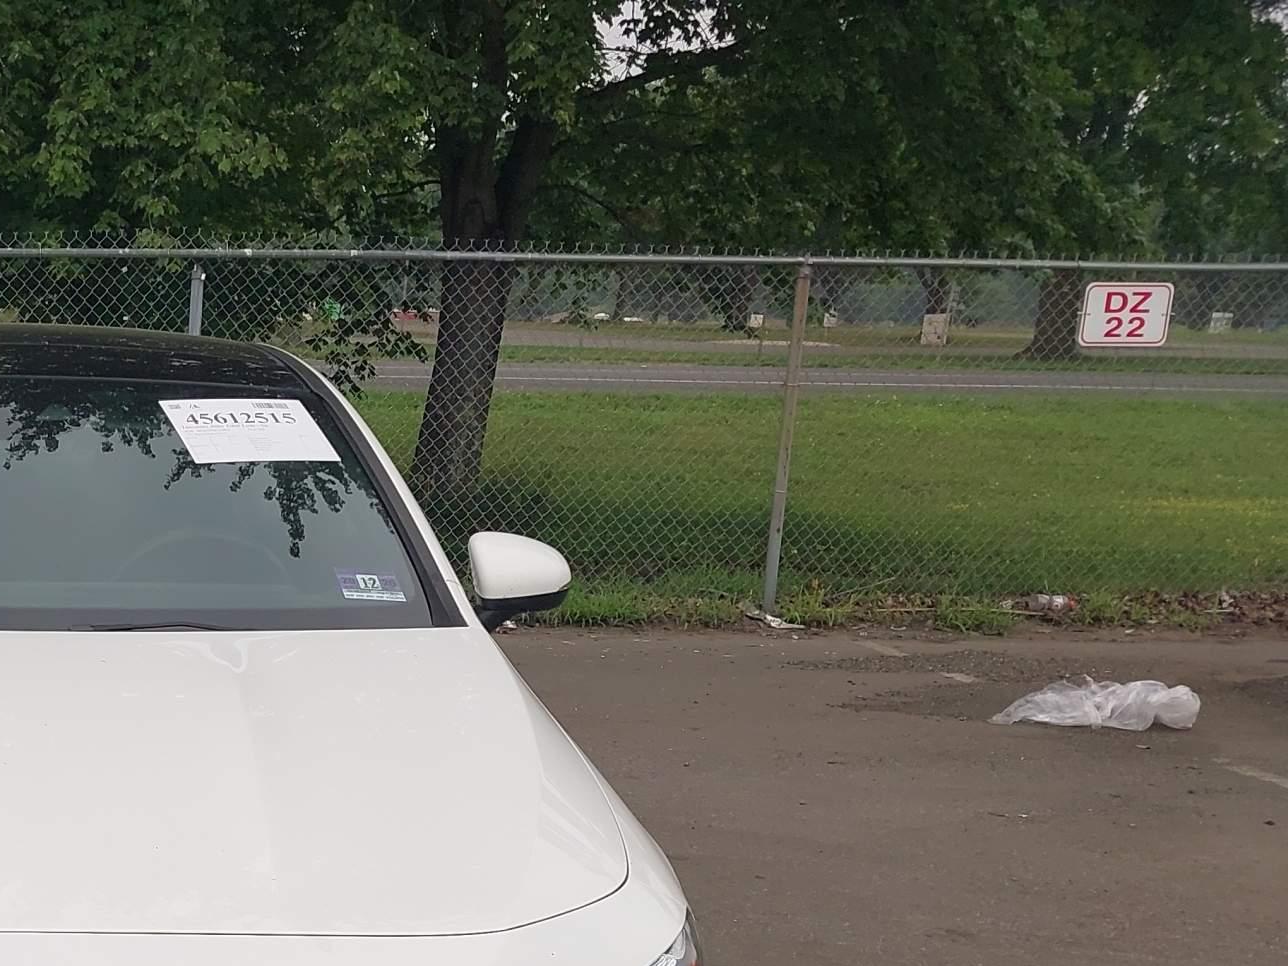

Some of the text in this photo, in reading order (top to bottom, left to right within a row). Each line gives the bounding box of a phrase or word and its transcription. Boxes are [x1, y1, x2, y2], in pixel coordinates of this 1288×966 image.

[1103, 291, 1153, 314] DZ
[1103, 316, 1146, 338] 22
[186, 412, 297, 425] 45612515
